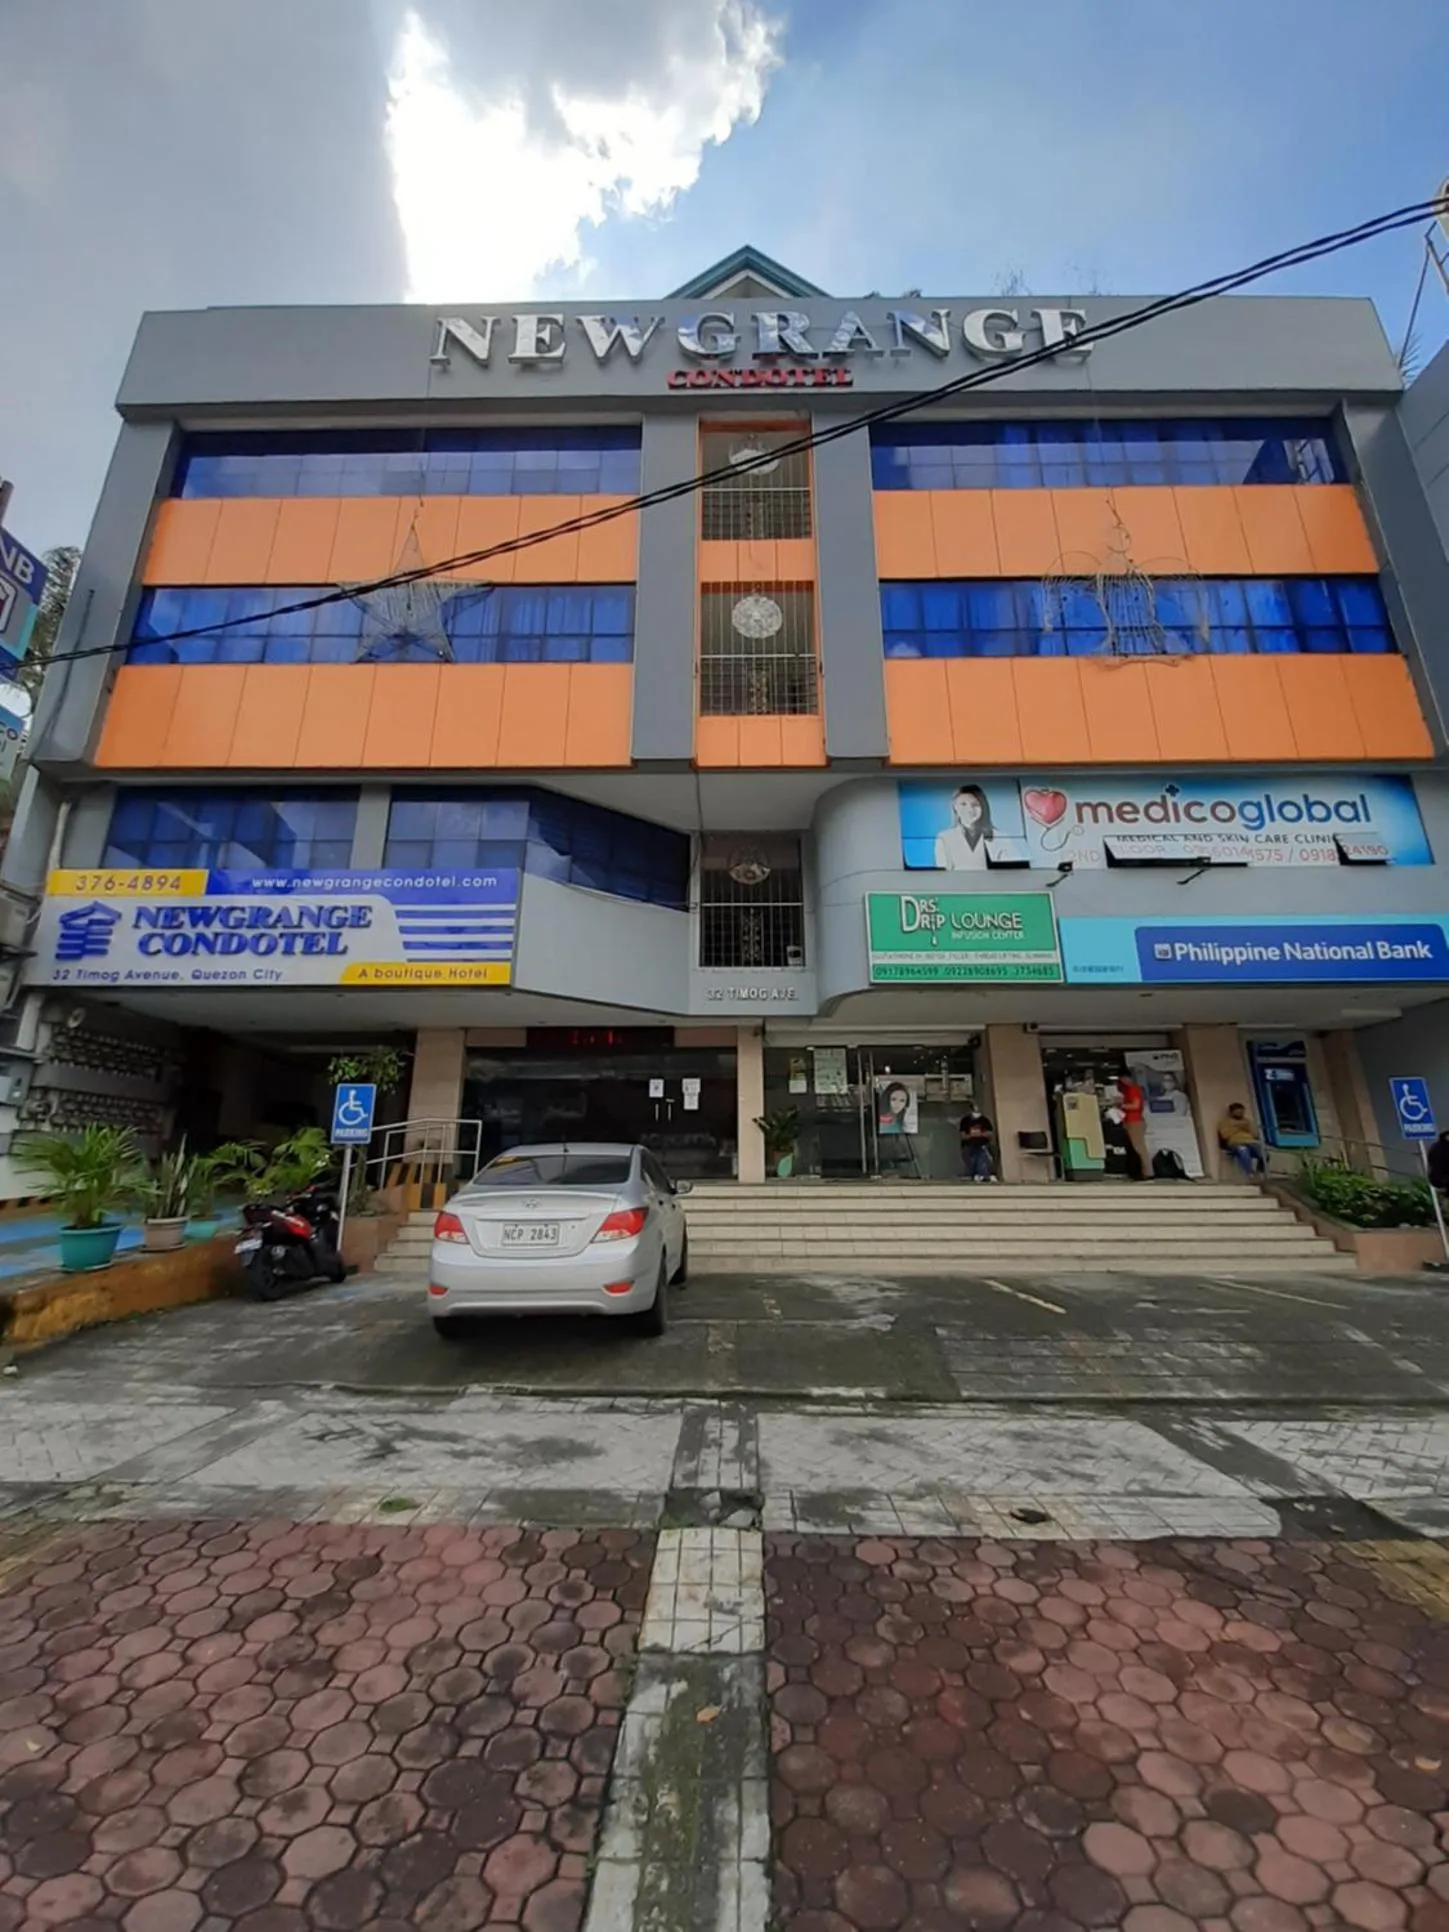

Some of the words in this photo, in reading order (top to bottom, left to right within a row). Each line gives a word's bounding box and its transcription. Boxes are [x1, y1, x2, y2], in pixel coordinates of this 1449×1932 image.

[667, 368, 853, 389] CONDOTEL
[1075, 787, 1371, 831] medicoglobal
[1254, 834, 1289, 844] CARE
[75, 874, 182, 891] 376-4894
[252, 876, 497, 891] www.newgrangecondotel.com
[132, 905, 373, 930] NEWGRANGE
[951, 912, 1024, 930] LOUNGE
[138, 932, 349, 957] CONDOTEL
[1174, 942, 1280, 966] Philippine
[1283, 941, 1373, 961] National
[1379, 940, 1432, 959] Bank
[52, 969, 71, 981] 32
[75, 969, 119, 984] Timog
[191, 969, 247, 981] Quezon
[253, 968, 283, 982] City
[358, 968, 369, 979] A
[374, 967, 443, 981] boutique
[448, 967, 488, 979] Hotel
